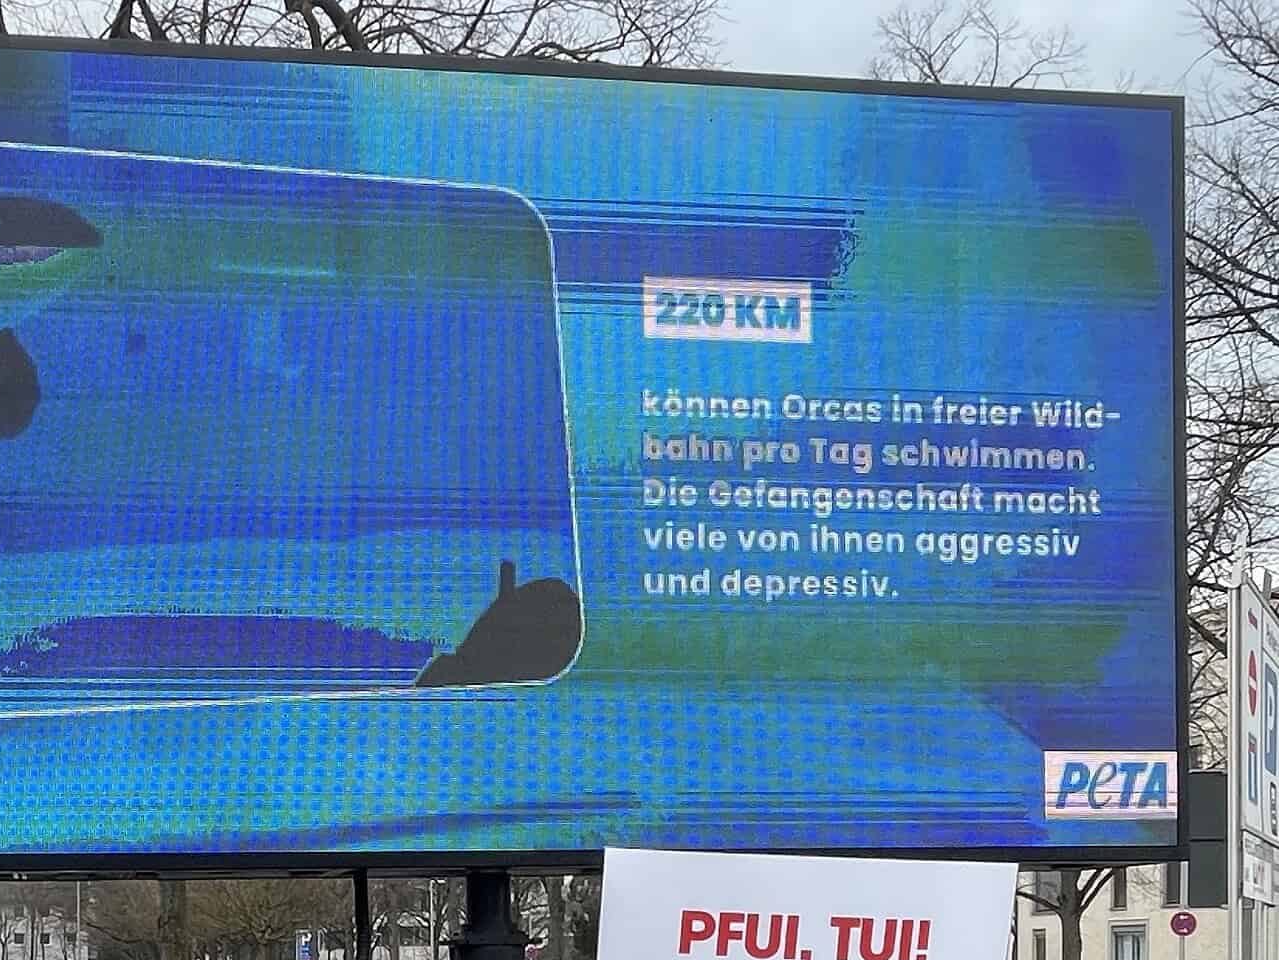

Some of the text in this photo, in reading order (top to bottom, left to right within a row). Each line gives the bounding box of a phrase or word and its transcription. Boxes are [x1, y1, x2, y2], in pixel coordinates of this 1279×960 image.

[656, 292, 801, 330] 220 KM
[643, 388, 1120, 428] können Orcas in freier Wild-
[644, 432, 1096, 474] bahn pro Tag schwimmen.
[644, 477, 1102, 518] Die Gefangenschaft macht
[644, 521, 1080, 563] viele von ihnen aggressiv
[644, 569, 898, 602] und depressiv.
